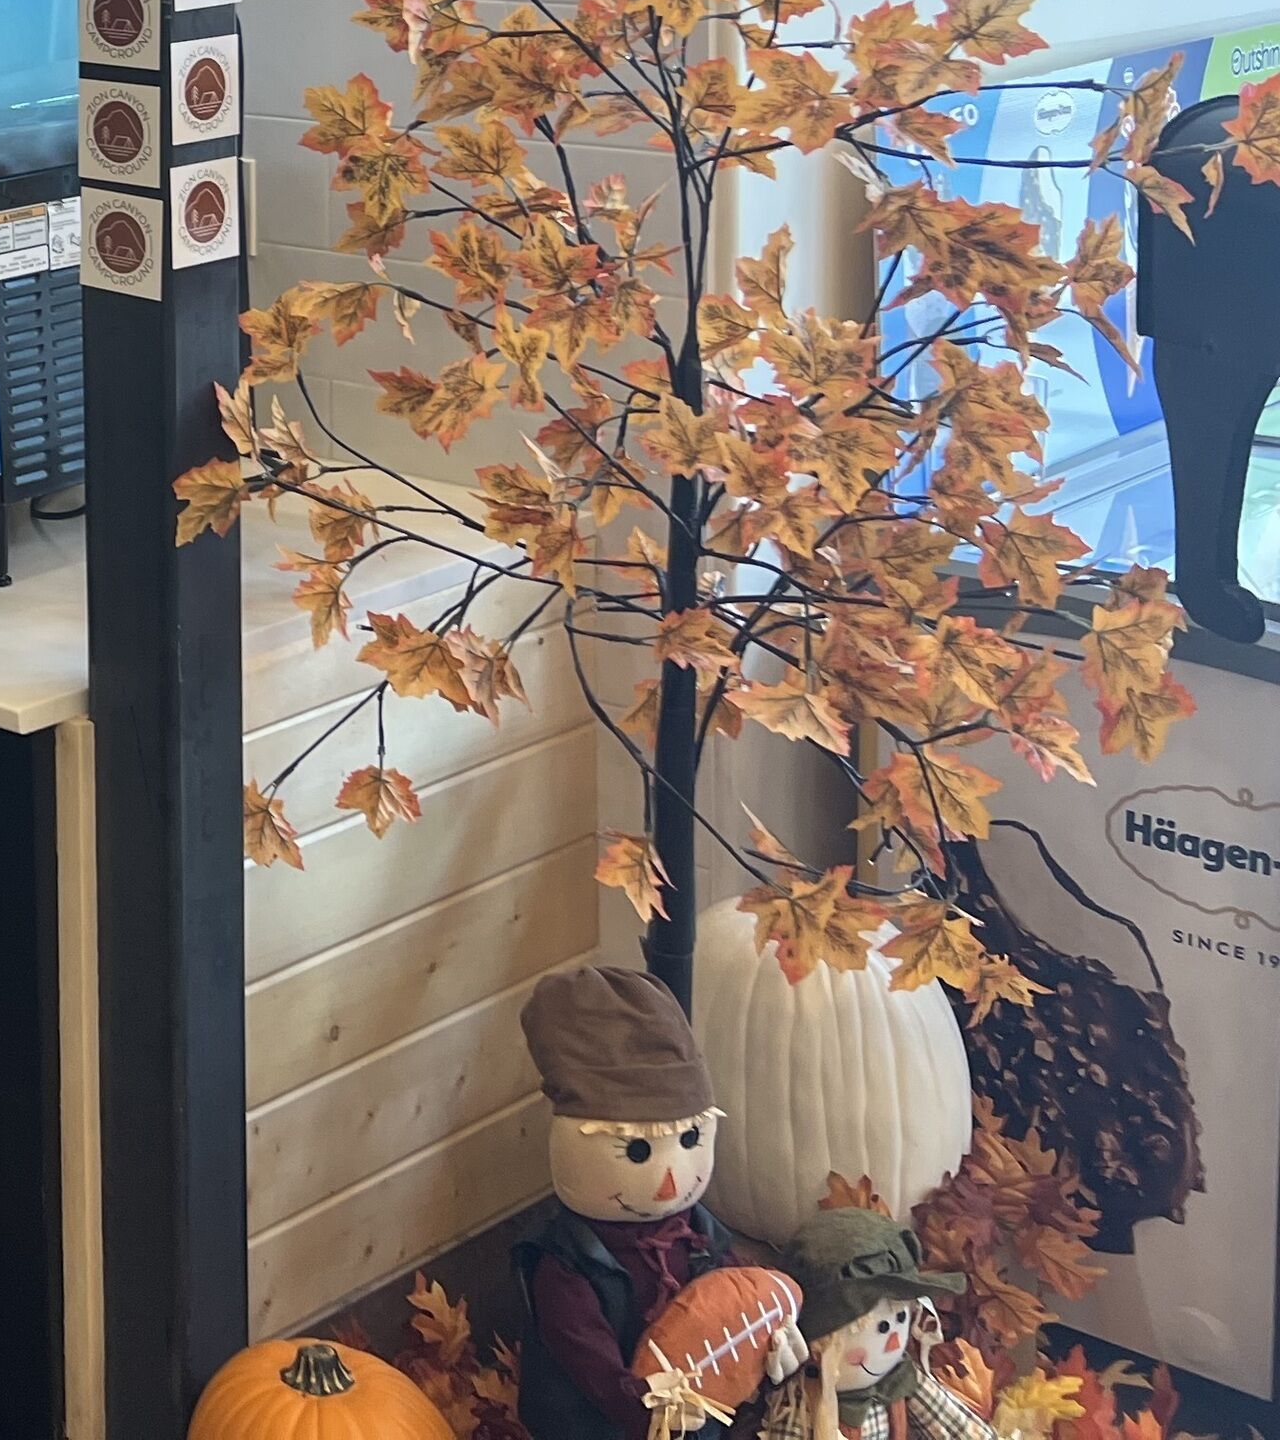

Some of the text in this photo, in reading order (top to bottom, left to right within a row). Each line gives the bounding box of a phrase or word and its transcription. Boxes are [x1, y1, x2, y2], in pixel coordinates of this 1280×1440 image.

[86, 22, 153, 59] CAMPGROUND
[178, 45, 231, 78] ZION CANYON
[86, 88, 151, 122] ZION CANYON
[178, 94, 233, 133] CAMPGROUND
[86, 137, 153, 176] CAMPGROUND
[178, 169, 231, 202] ZION CANYON
[88, 201, 111, 225] ZION
[112, 199, 153, 234] CANYON
[178, 216, 233, 256] CAMPGROUND
[88, 246, 154, 287] CAMPGROUND
[1172, 929, 1246, 961] SINCE
